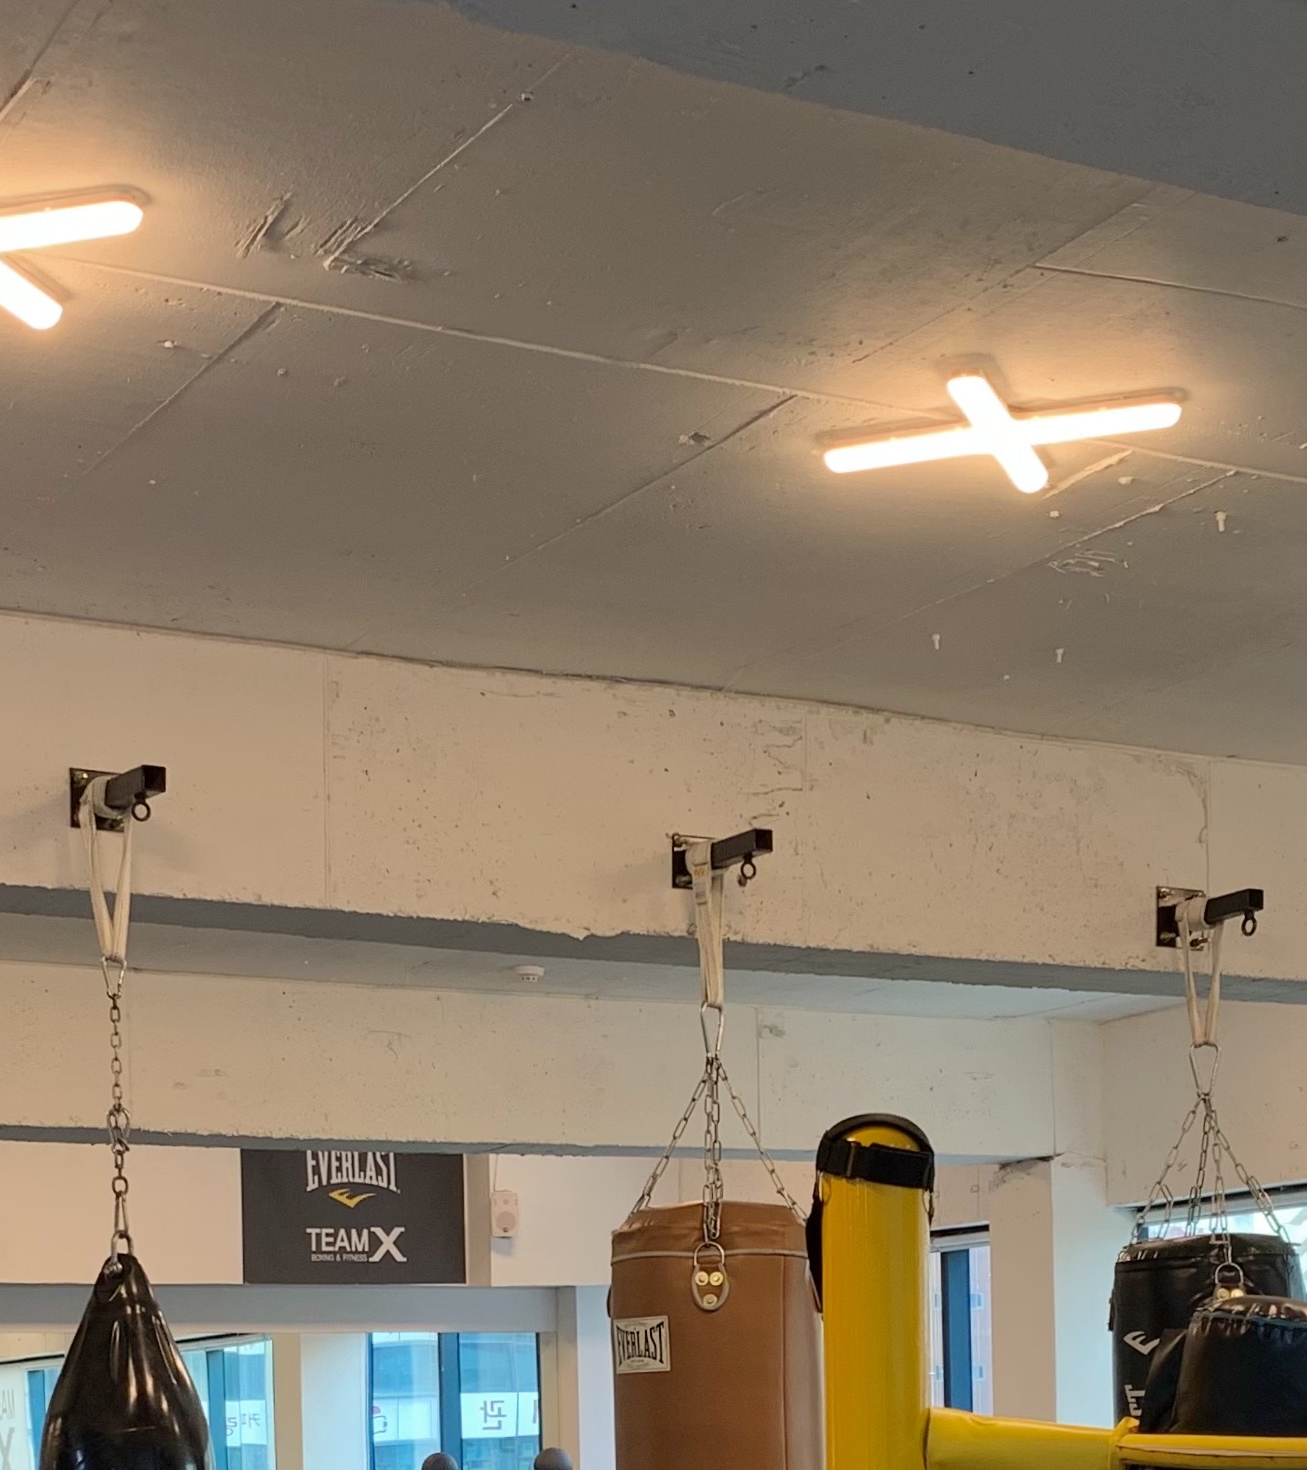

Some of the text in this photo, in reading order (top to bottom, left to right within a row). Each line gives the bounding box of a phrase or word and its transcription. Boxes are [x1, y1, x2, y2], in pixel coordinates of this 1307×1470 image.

[306, 1150, 398, 1192] EVERLAST
[306, 1227, 407, 1262] TEAM X
[615, 1321, 665, 1367] EVERLAST
